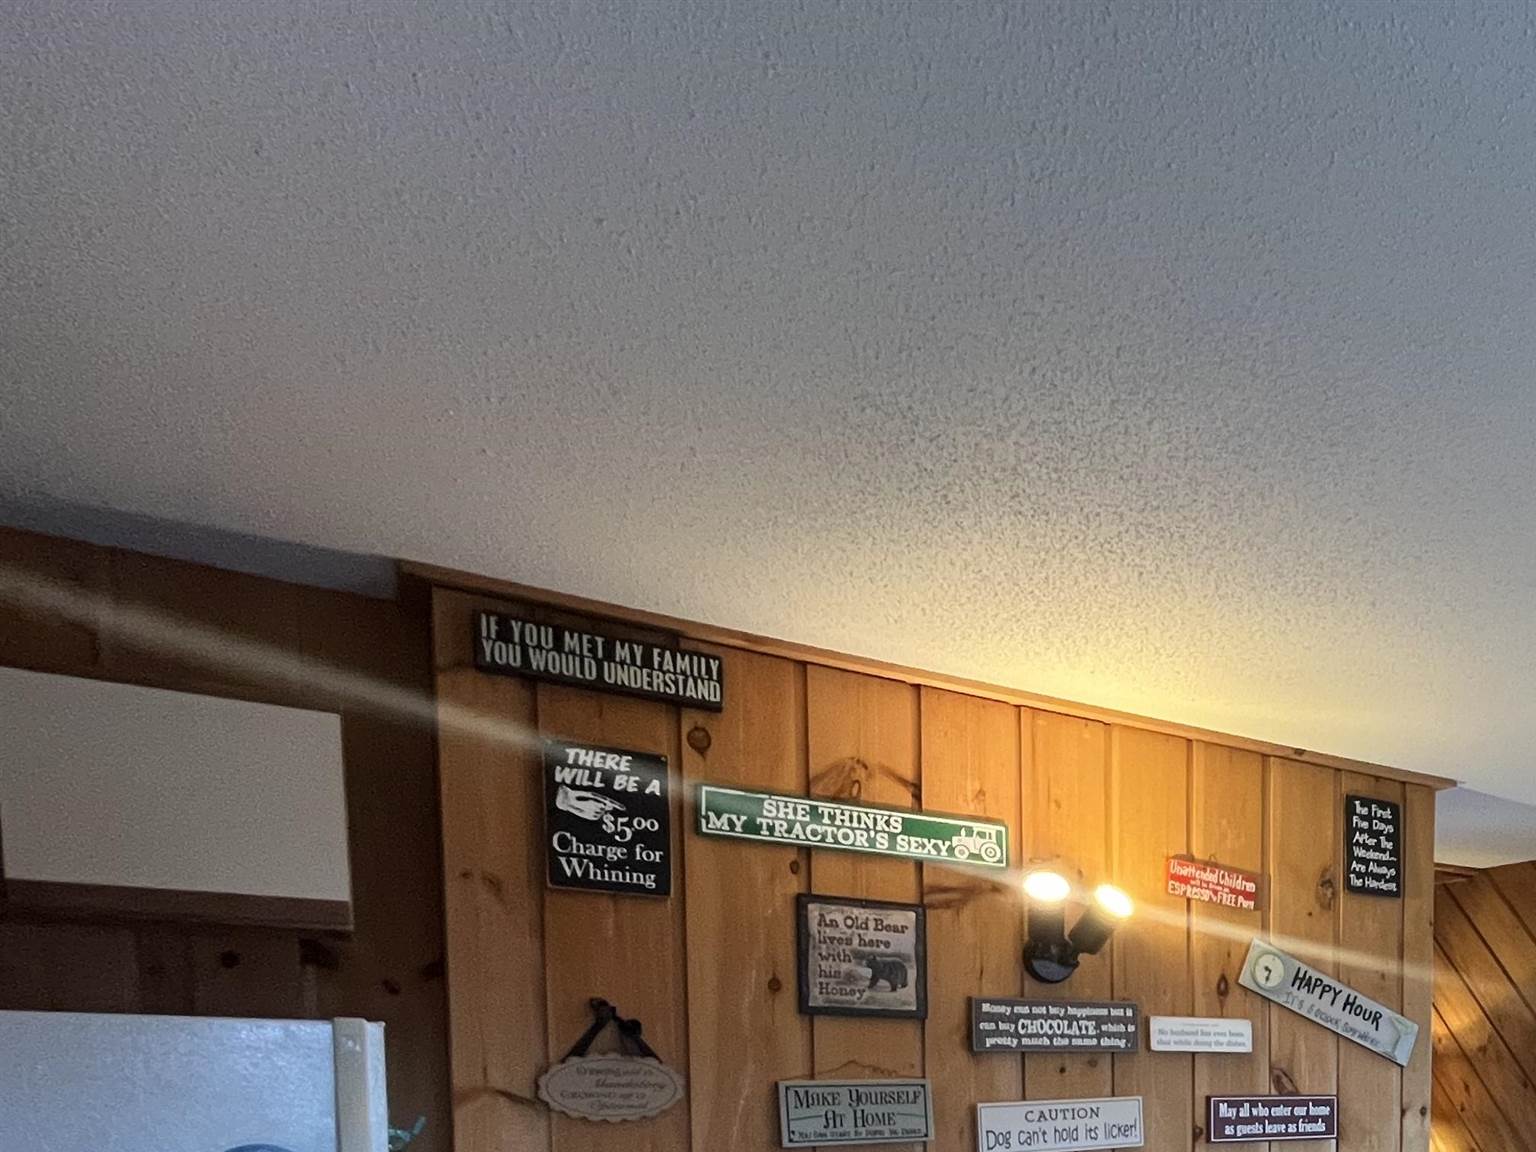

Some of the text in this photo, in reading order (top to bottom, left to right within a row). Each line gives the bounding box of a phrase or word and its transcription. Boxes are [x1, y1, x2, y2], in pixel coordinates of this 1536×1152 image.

[481, 613, 720, 680] IF YOU MET MY FAMILY
[482, 638, 720, 702] YOU WOULD UNDERSTAND
[566, 748, 632, 771] THERE
[554, 766, 661, 796] WILL BE A
[763, 799, 903, 834] SHE THINKS
[1354, 800, 1392, 819] The First
[602, 813, 659, 842] $5.00
[707, 811, 953, 857] MY TRACTOR'S SEXY
[1353, 816, 1393, 834] Five Days
[552, 831, 663, 862] Charge for
[1353, 832, 1393, 849] After The
[558, 856, 656, 889] Whining
[1170, 860, 1255, 892] Unattended Children
[1351, 860, 1396, 879] Are Always
[1349, 873, 1363, 887] The
[1168, 881, 1210, 901] ESPRESSO
[1217, 890, 1237, 907] FREE
[817, 913, 909, 934] An Old Bear
[817, 930, 891, 949] lives here
[818, 949, 852, 963] with
[818, 964, 841, 979] his
[818, 982, 866, 1000] Honey
[1291, 966, 1383, 1031] HAPPY HOUR
[1049, 1005, 1065, 1017] buy
[999, 1021, 1015, 1032] buy
[1101, 1023, 1125, 1032] which
[986, 1036, 1018, 1048] pretty
[1021, 1036, 1050, 1045] much
[1053, 1037, 1069, 1045] the
[1024, 1107, 1100, 1122] CAUTION
[1219, 1101, 1330, 1120] May all who enter our home
[986, 1118, 1138, 1150] Dog can't hold its licker!
[1225, 1118, 1326, 1137] as guests leave as friends
